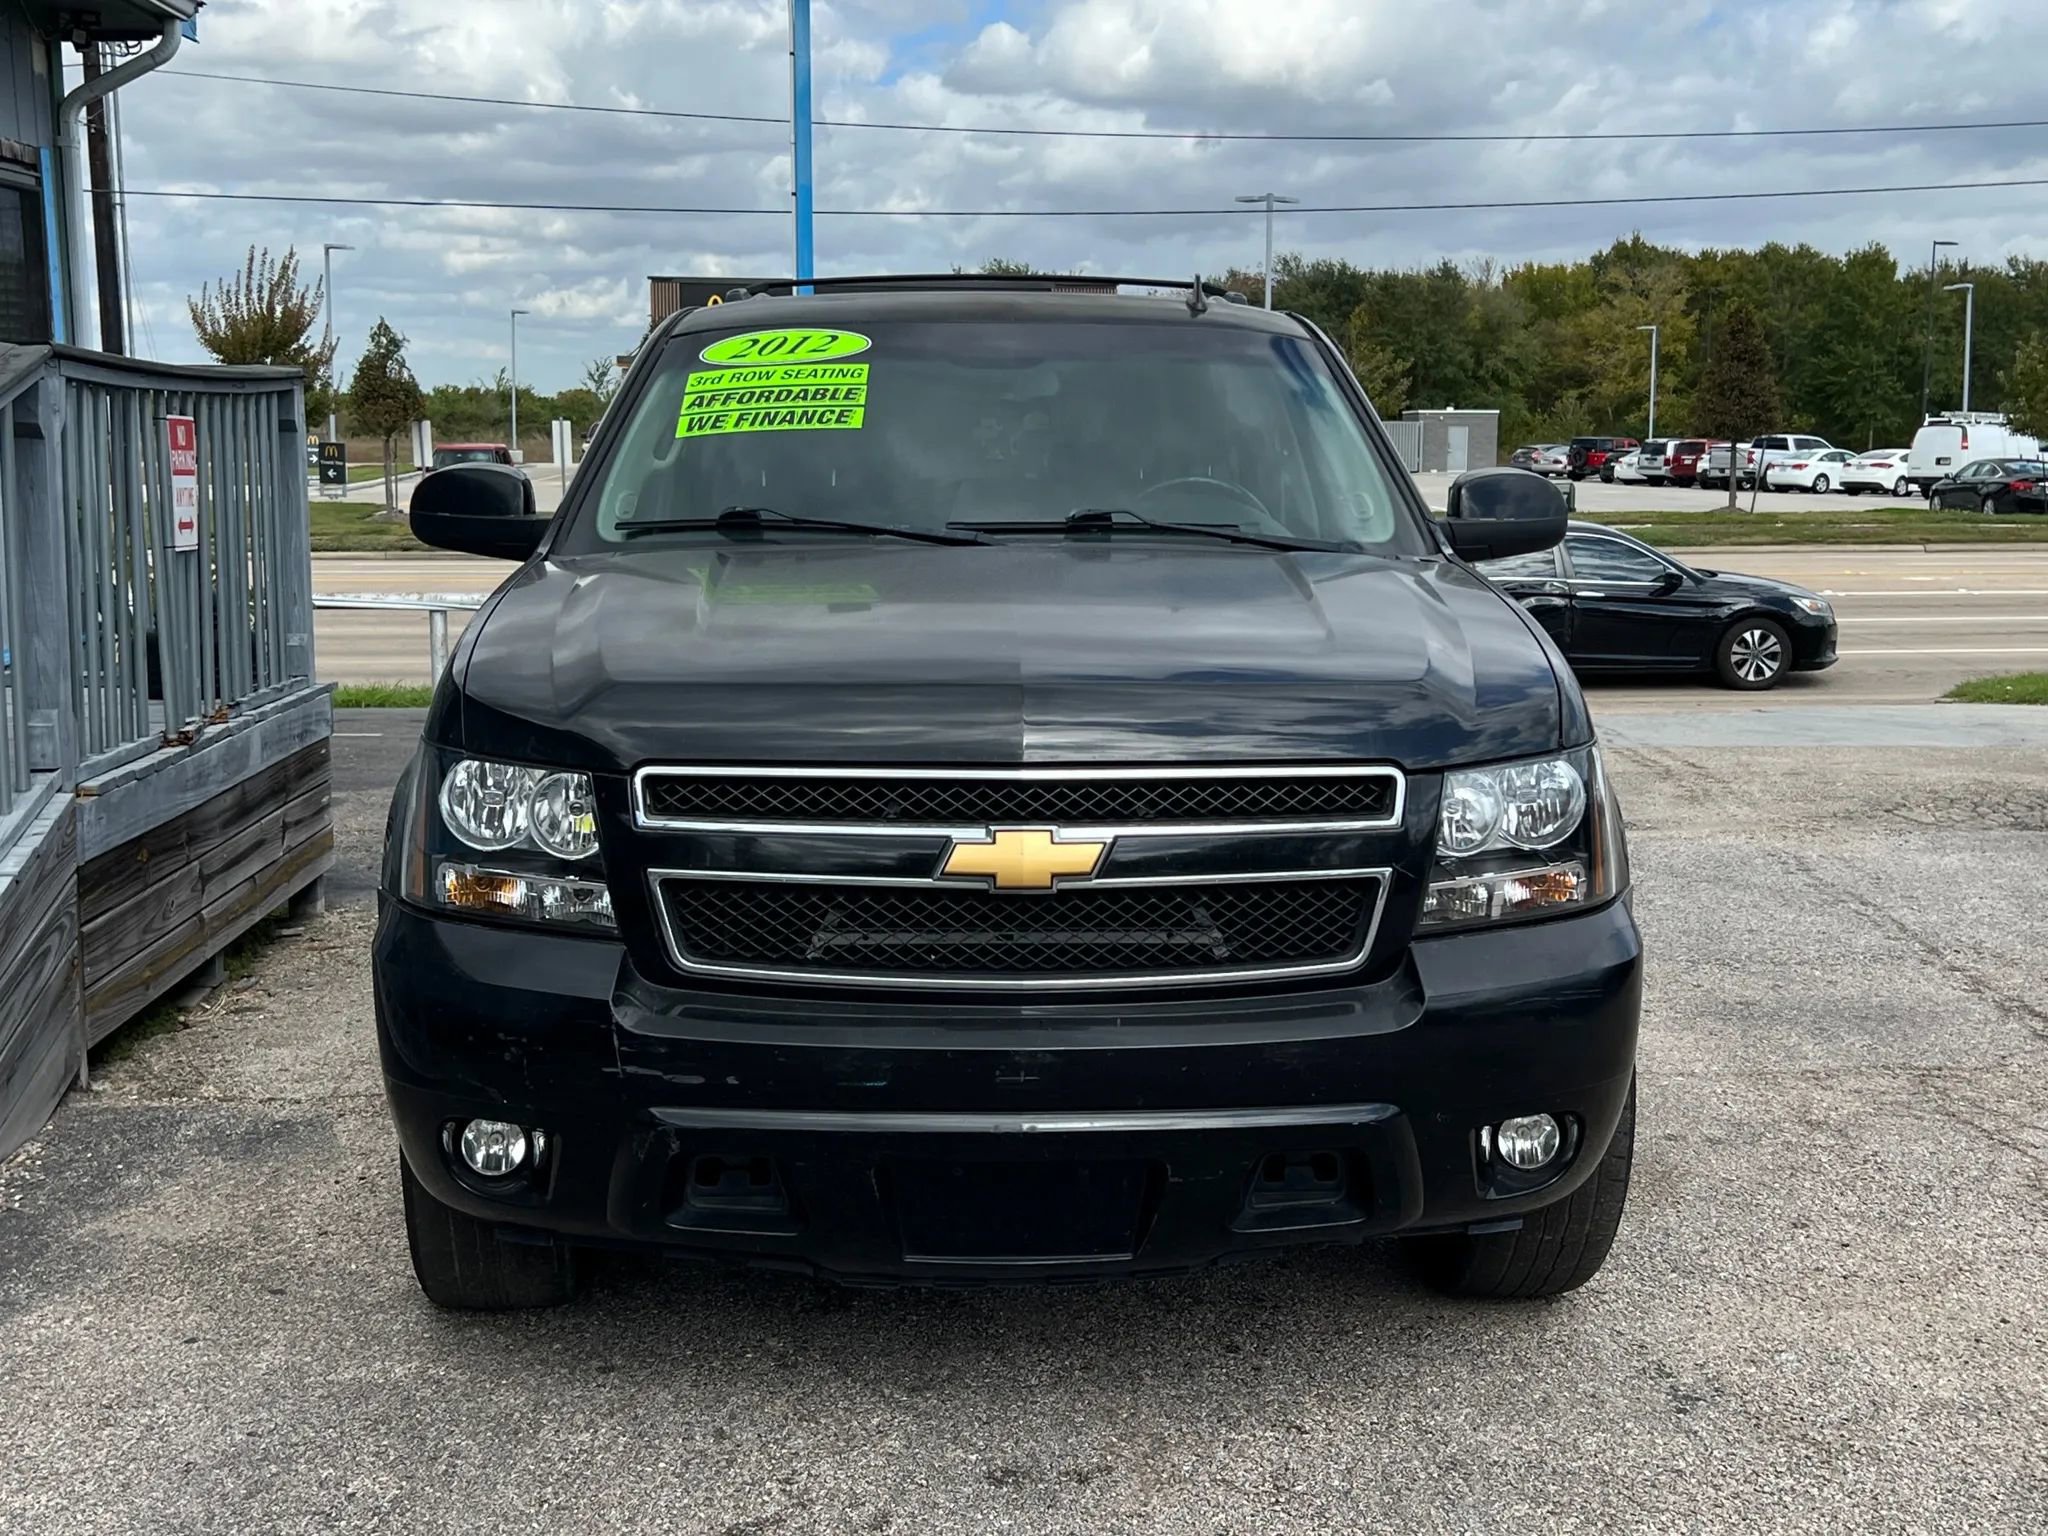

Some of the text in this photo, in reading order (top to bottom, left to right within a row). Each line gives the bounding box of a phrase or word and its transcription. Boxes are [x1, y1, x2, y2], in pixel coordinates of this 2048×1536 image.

[726, 334, 840, 360] 2012
[689, 367, 865, 387] 3rd ROW SEATING
[685, 387, 865, 411] AFFORDABLE
[686, 408, 854, 434] WE FINANCE
[176, 425, 186, 447] NO
[171, 450, 194, 470] PARKING
